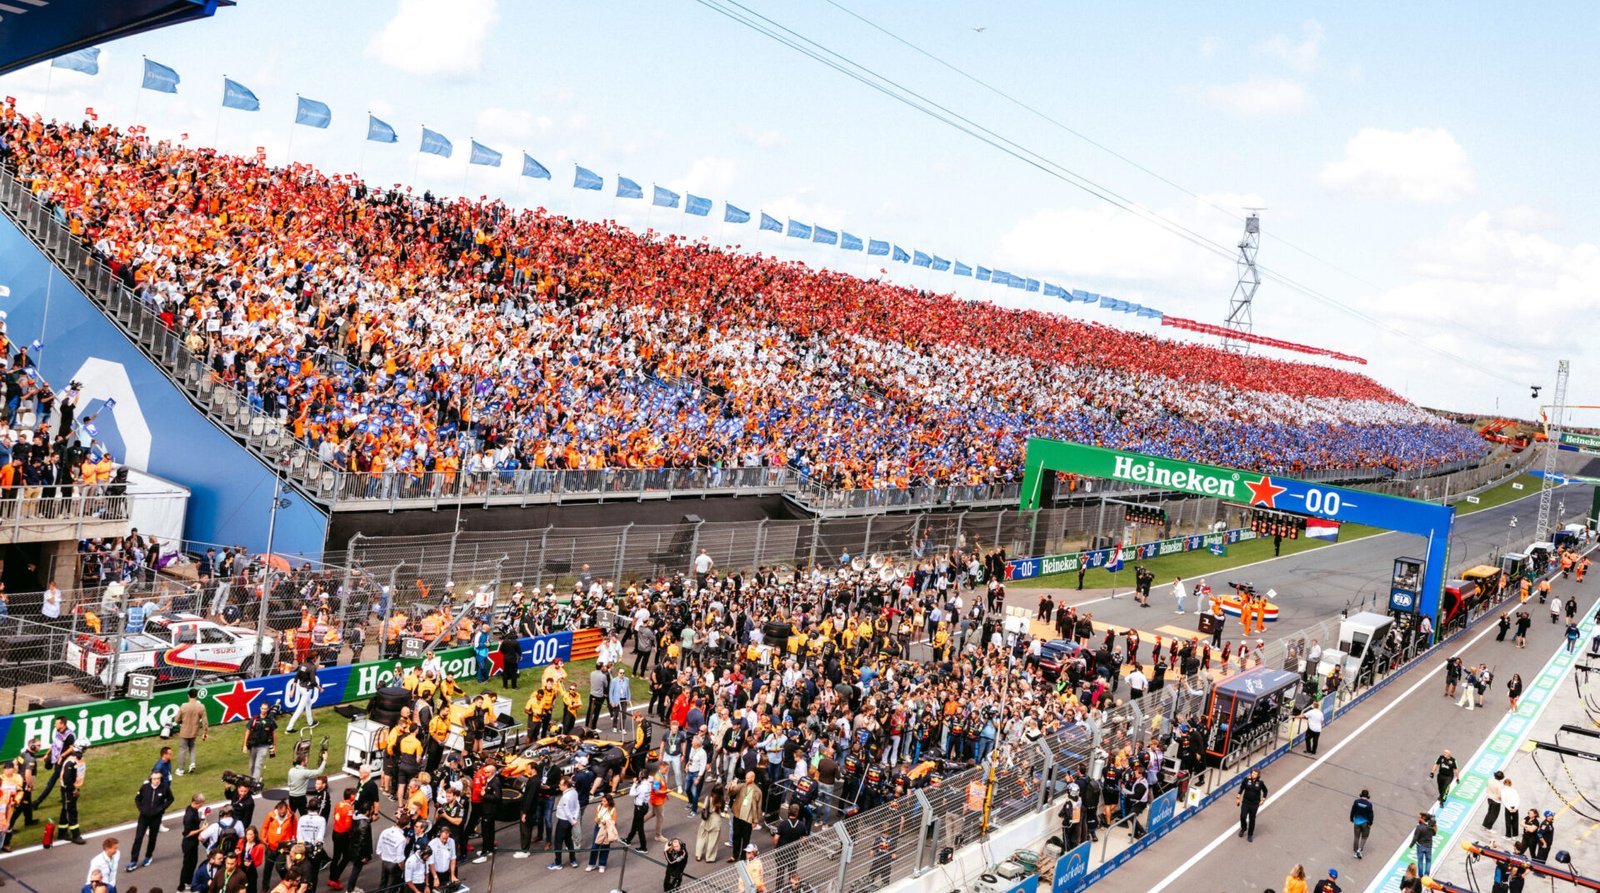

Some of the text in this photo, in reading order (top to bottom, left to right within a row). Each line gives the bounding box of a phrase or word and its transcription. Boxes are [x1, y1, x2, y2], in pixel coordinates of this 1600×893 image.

[1393, 594, 1411, 605] FIA
[603, 612, 608, 620] 1
[406, 640, 419, 649] 81
[533, 637, 558, 665] 0.0
[132, 676, 149, 688] 63
[130, 689, 148, 697] RUS
[1152, 806, 1173, 826] workday
[1058, 861, 1085, 887] workday
